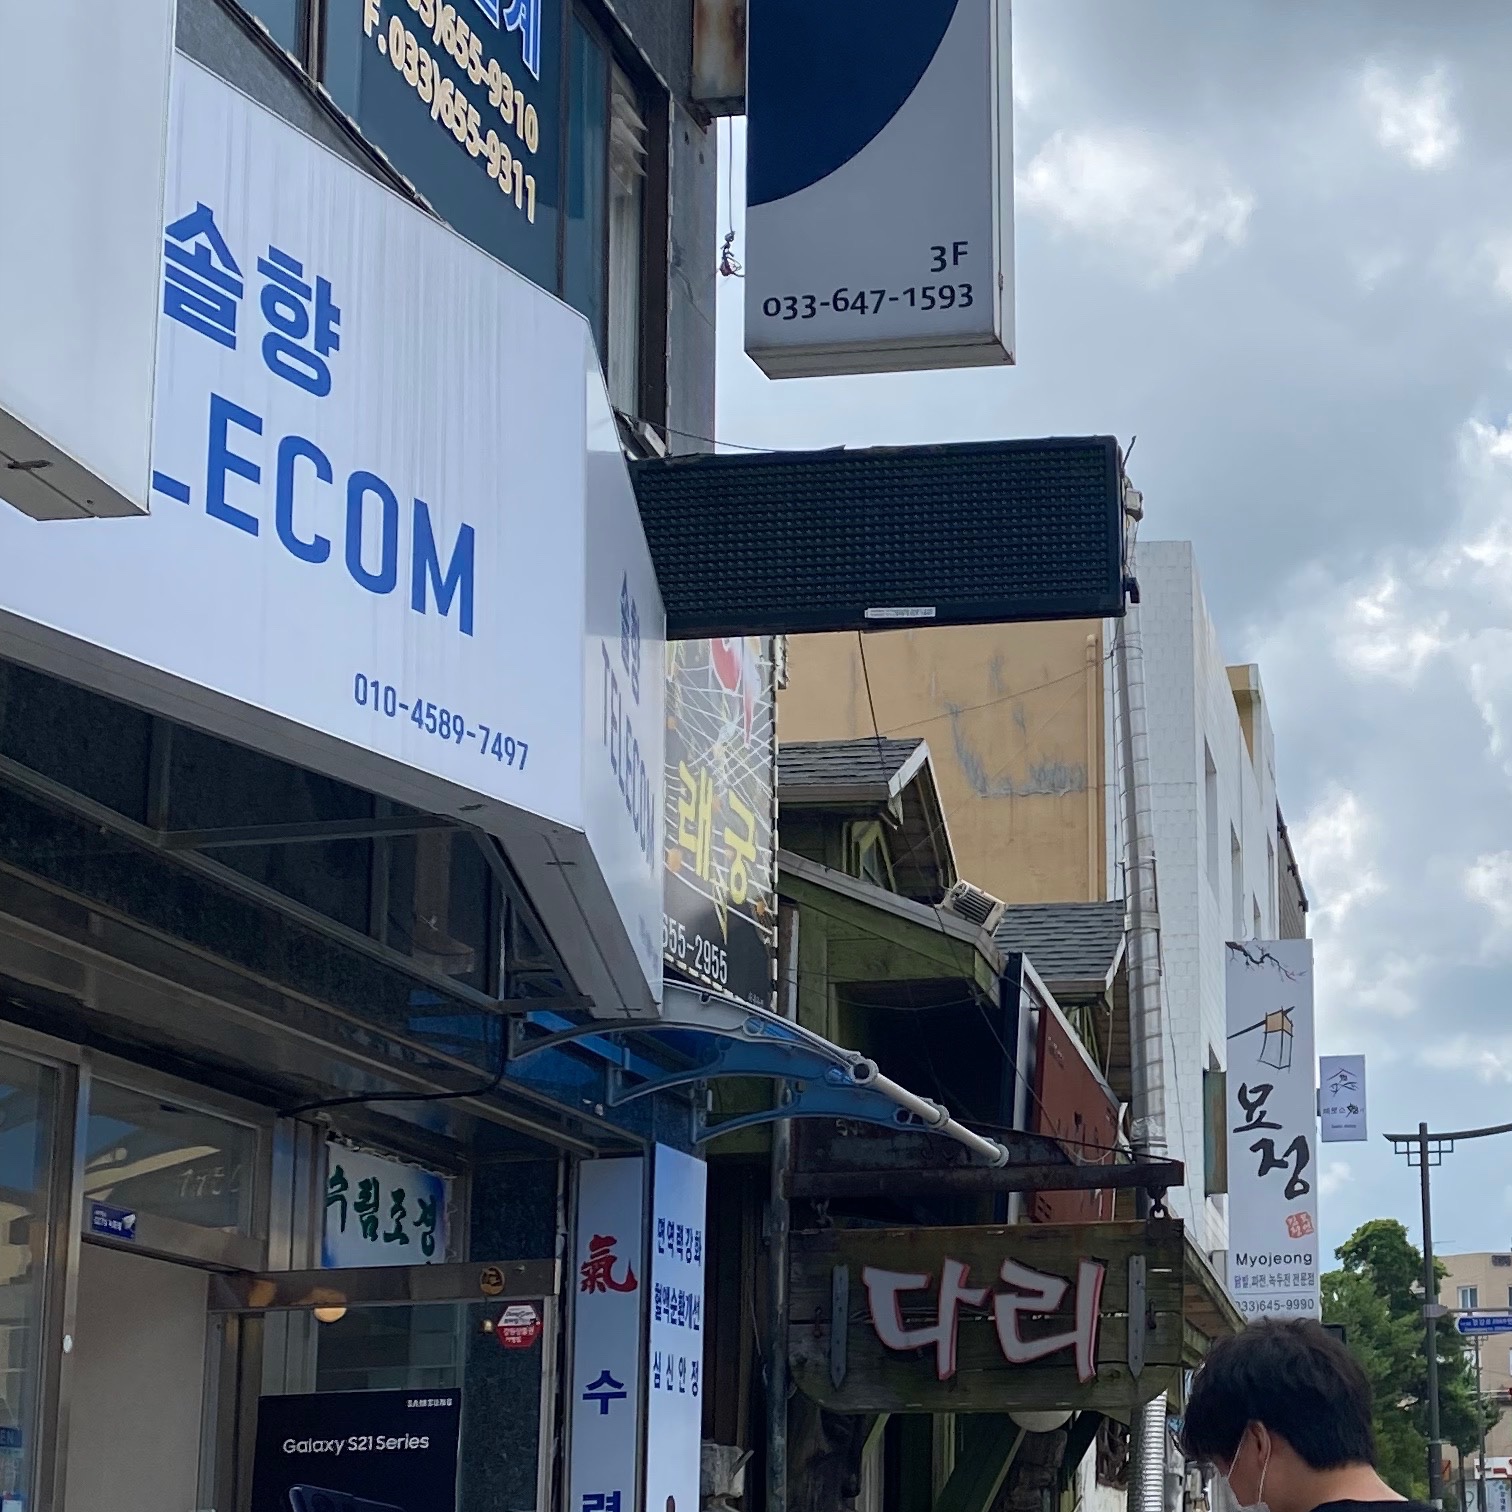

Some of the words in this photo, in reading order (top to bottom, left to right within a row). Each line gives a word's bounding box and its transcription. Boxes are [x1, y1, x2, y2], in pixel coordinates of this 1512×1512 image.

[930, 241, 968, 272] 3F
[163, 200, 341, 397] 솔향
[762, 283, 974, 320] 033-647-1593
[354, 673, 529, 772] 010-4589-7497
[1236, 1252, 1312, 1268] Myojeong
[862, 1255, 1107, 1384] 다리
[283, 1438, 345, 1456] Galaxy
[347, 1436, 373, 1451] S21
[375, 1433, 430, 1450] Series
